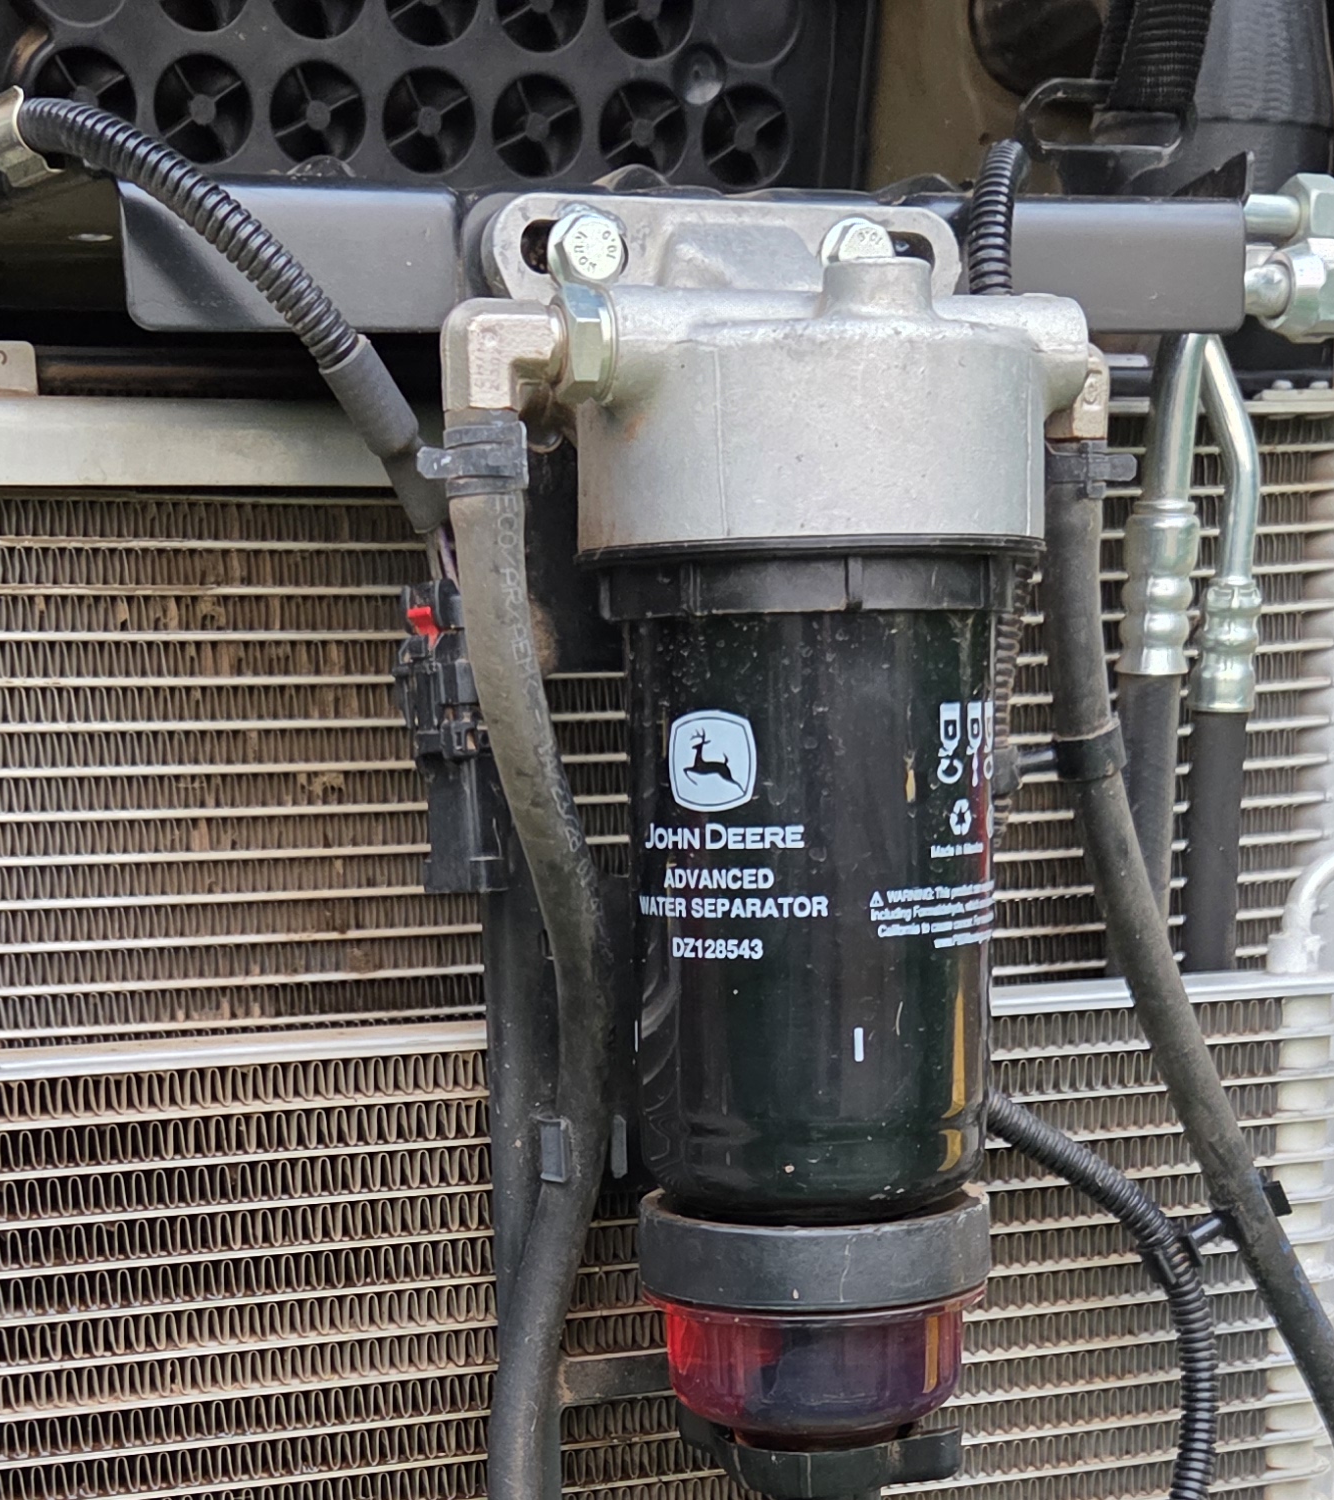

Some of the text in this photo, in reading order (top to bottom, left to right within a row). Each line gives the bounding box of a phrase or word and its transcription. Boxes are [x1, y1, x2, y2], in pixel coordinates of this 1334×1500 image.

[644, 822, 805, 850] JOHN DEERE
[663, 867, 775, 890] ADVANCED
[639, 895, 829, 919] WATER SEPARATOR
[671, 936, 764, 960] DZ128543
